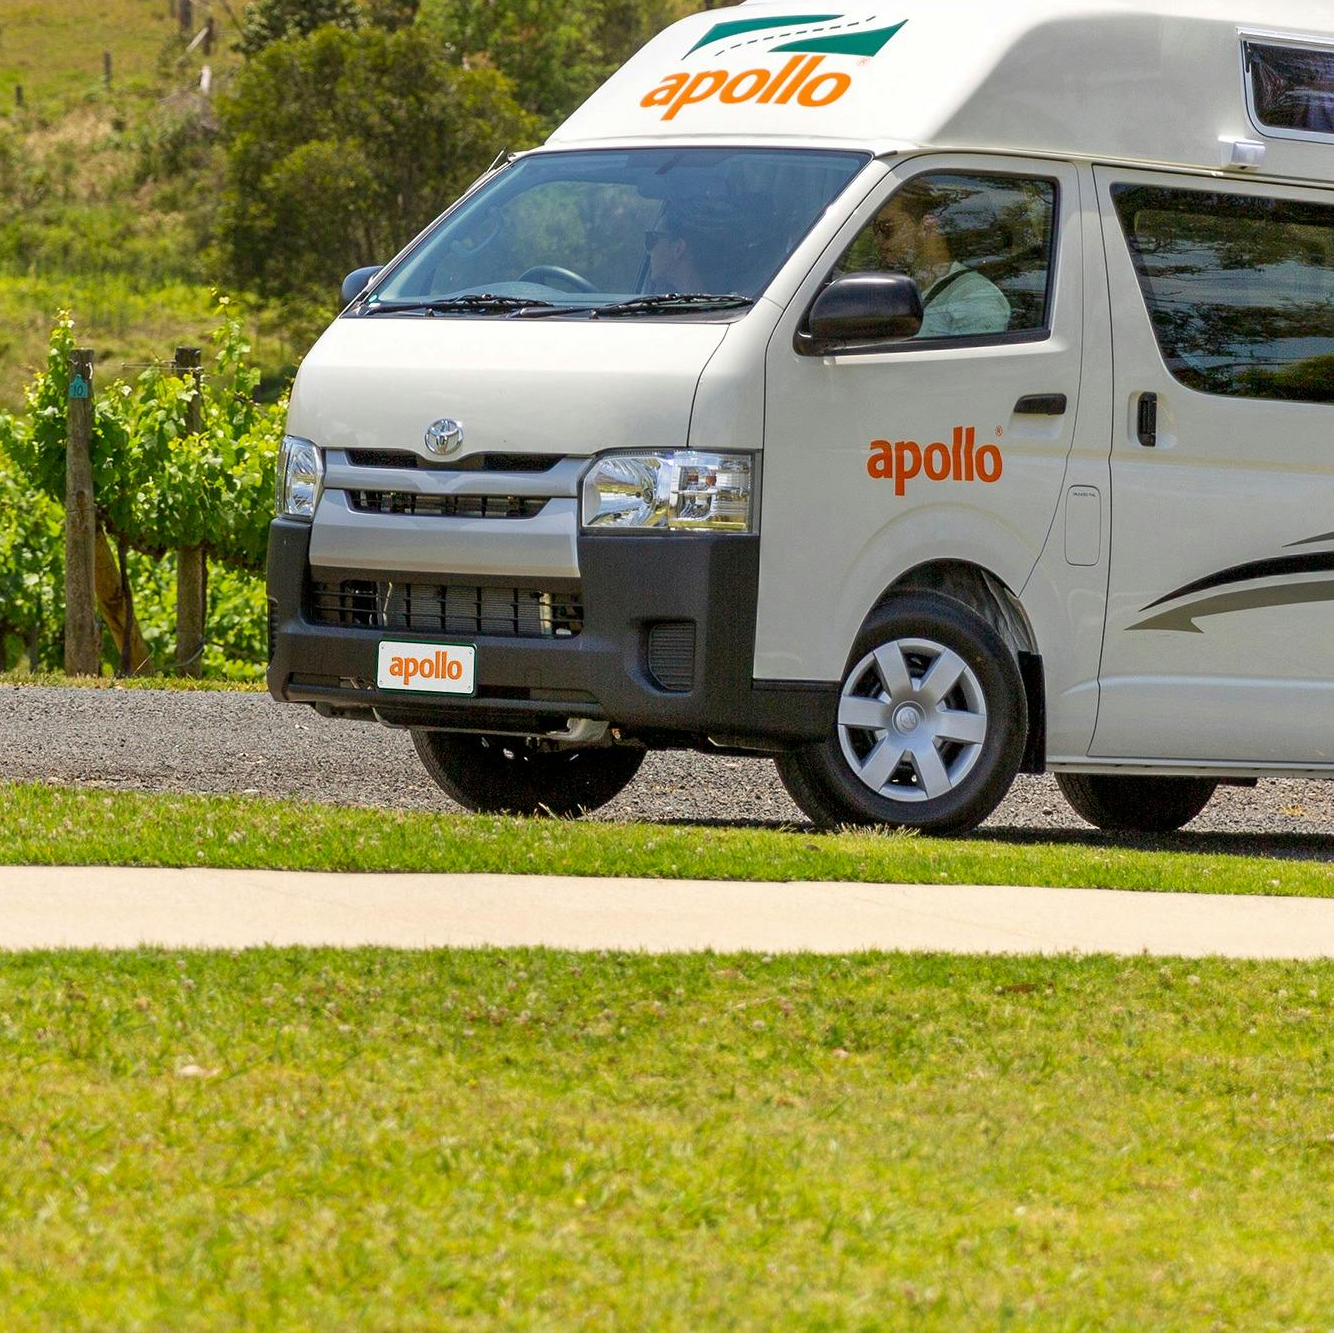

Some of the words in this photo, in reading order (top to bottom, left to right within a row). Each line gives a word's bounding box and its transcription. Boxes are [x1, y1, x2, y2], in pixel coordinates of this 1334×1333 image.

[640, 54, 852, 121] apollo
[867, 426, 1003, 496] apollo
[389, 651, 463, 685] apollo
